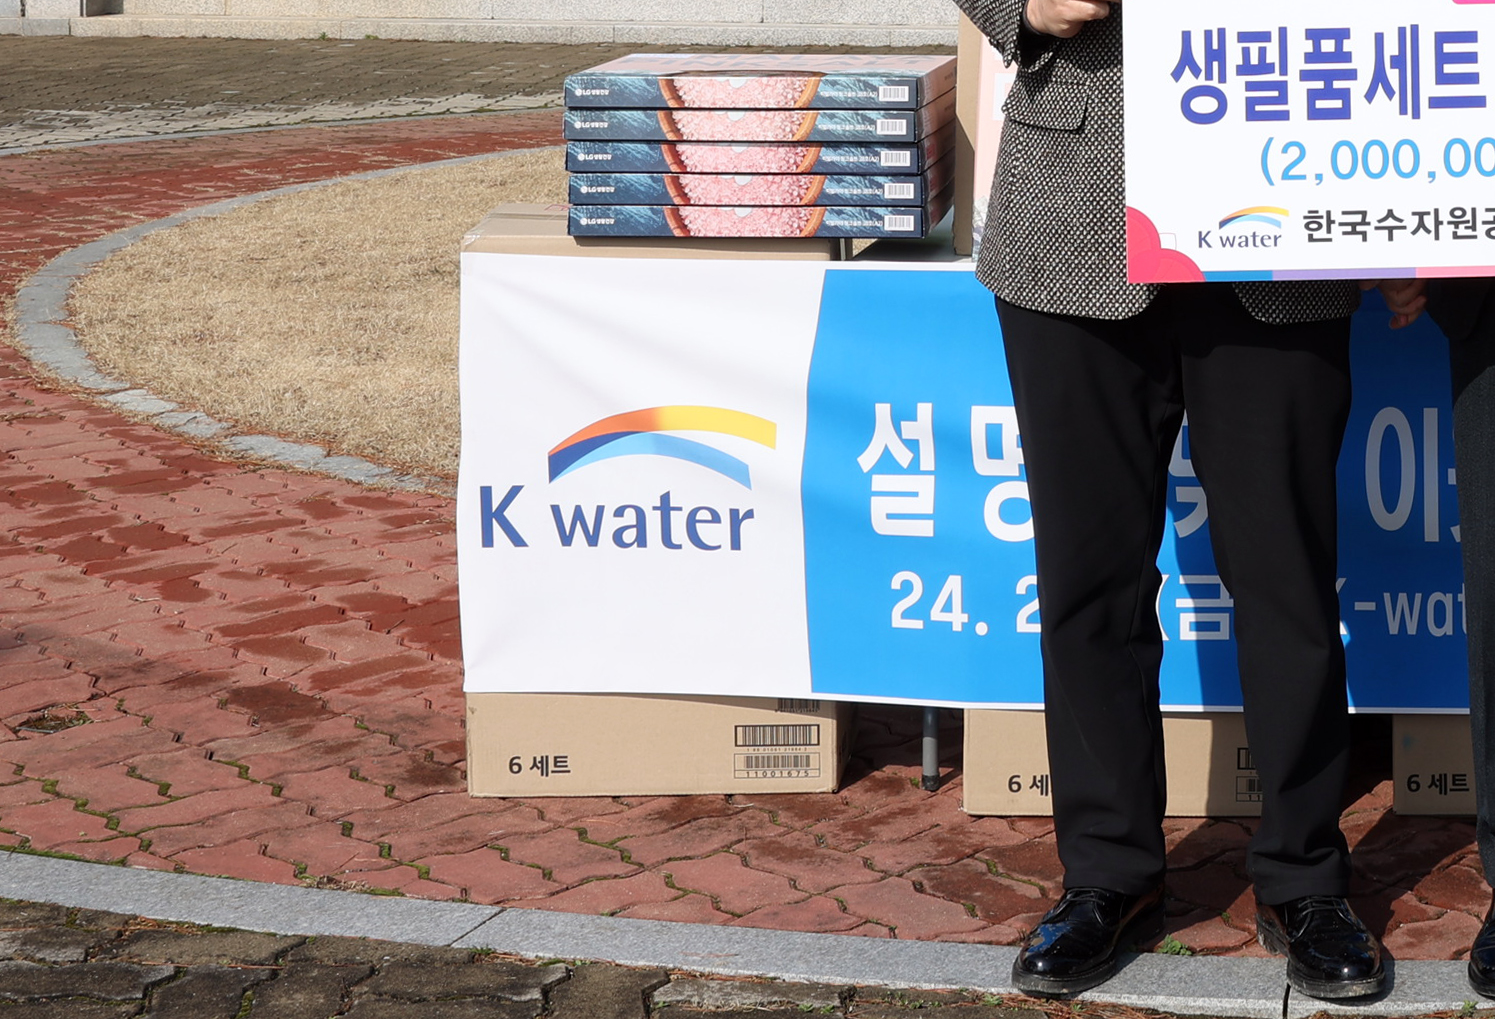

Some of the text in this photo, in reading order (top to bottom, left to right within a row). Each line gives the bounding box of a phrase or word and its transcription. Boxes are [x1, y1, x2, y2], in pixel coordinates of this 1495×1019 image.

[1170, 23, 1488, 125] 생필품세트
[1198, 227, 1282, 249] K water
[480, 484, 755, 551] K water
[890, 570, 988, 636] 24.
[508, 754, 571, 777] 6 세트
[746, 770, 809, 778] 11001675
[1029, 773, 1049, 797] 세
[1406, 772, 1470, 797] 6 세트
